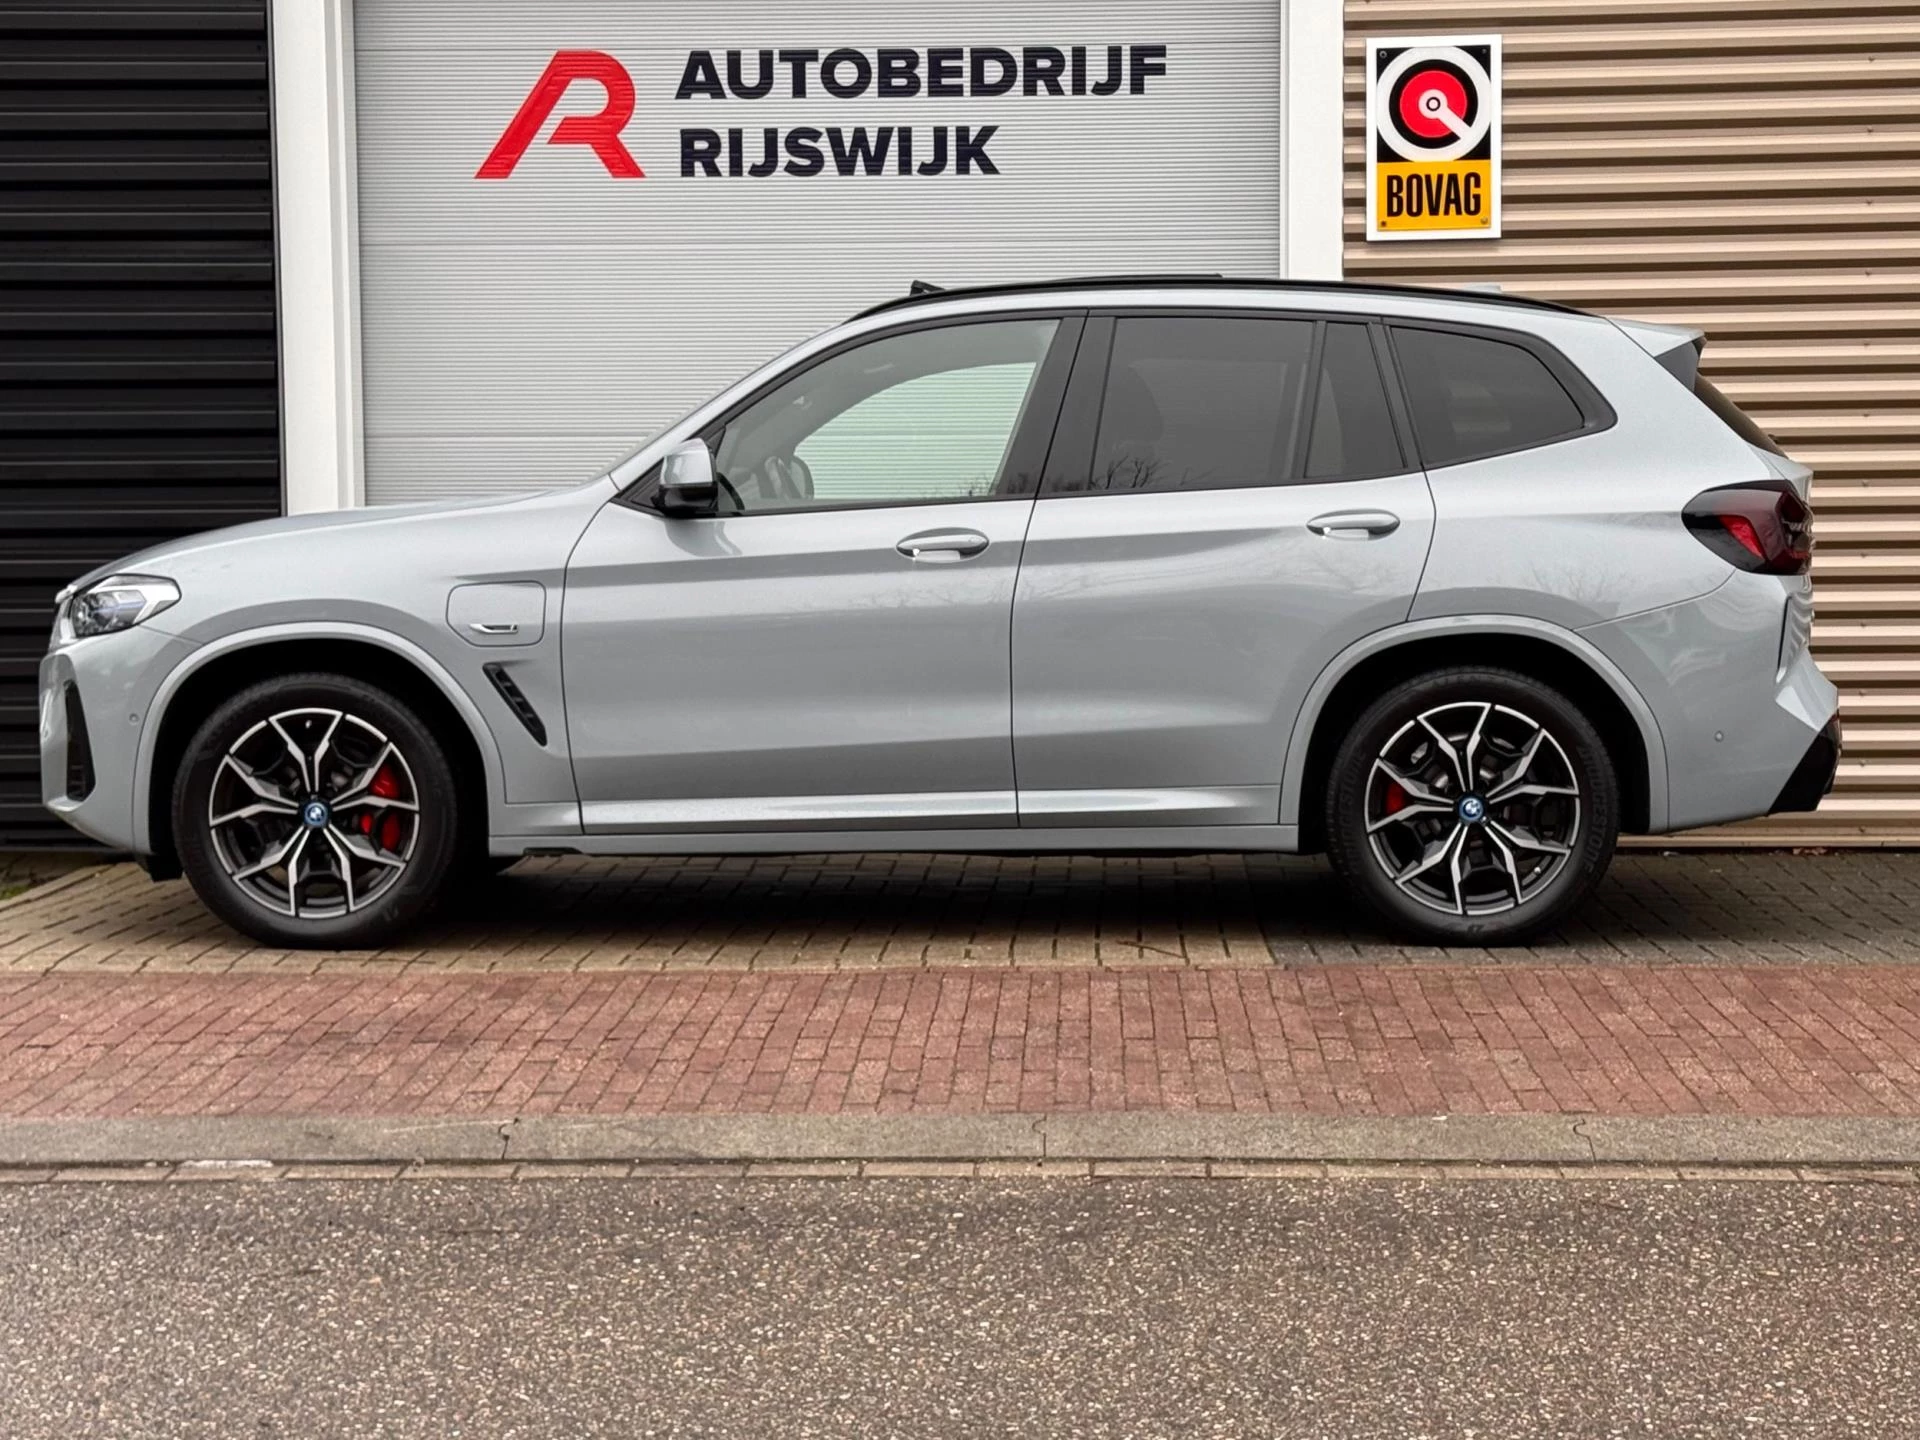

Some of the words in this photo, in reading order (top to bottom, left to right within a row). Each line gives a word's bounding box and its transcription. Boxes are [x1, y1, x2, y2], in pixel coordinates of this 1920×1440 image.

[676, 45, 1167, 100] AUTOBEDRIJF
[680, 125, 1000, 178] RIJSWIJK
[1386, 172, 1482, 217] BOVAG
